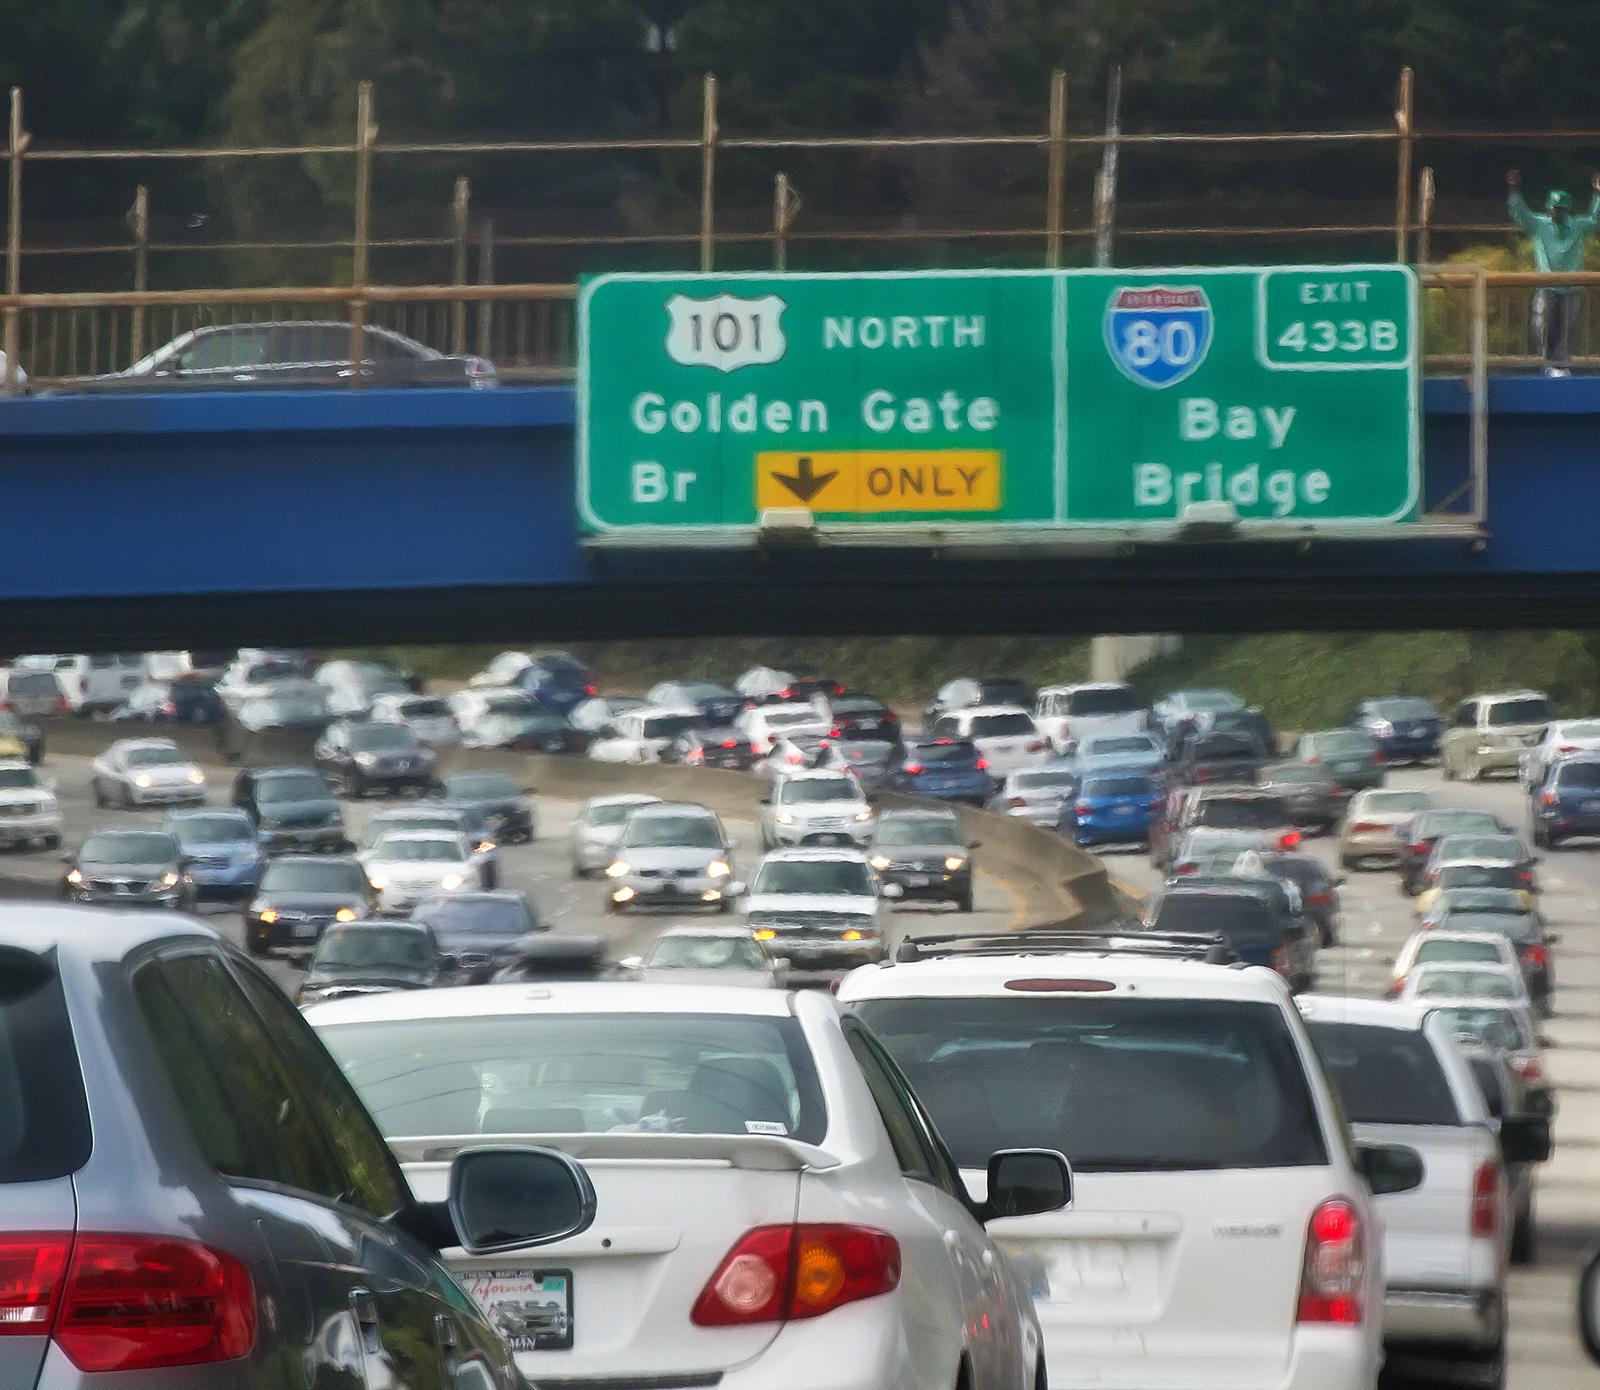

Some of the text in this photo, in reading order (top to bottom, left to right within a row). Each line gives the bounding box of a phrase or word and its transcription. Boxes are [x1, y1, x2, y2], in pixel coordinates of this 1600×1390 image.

[1299, 280, 1371, 304] EXIT
[691, 312, 986, 353] 101 NORTH
[1123, 319, 1196, 366] 80
[1278, 320, 1398, 352] 433B
[631, 389, 1002, 433] Golden Gate
[1177, 397, 1297, 449] Bay
[631, 461, 697, 503] Br
[867, 467, 987, 498] ONLY
[1132, 463, 1332, 517] Bridge
